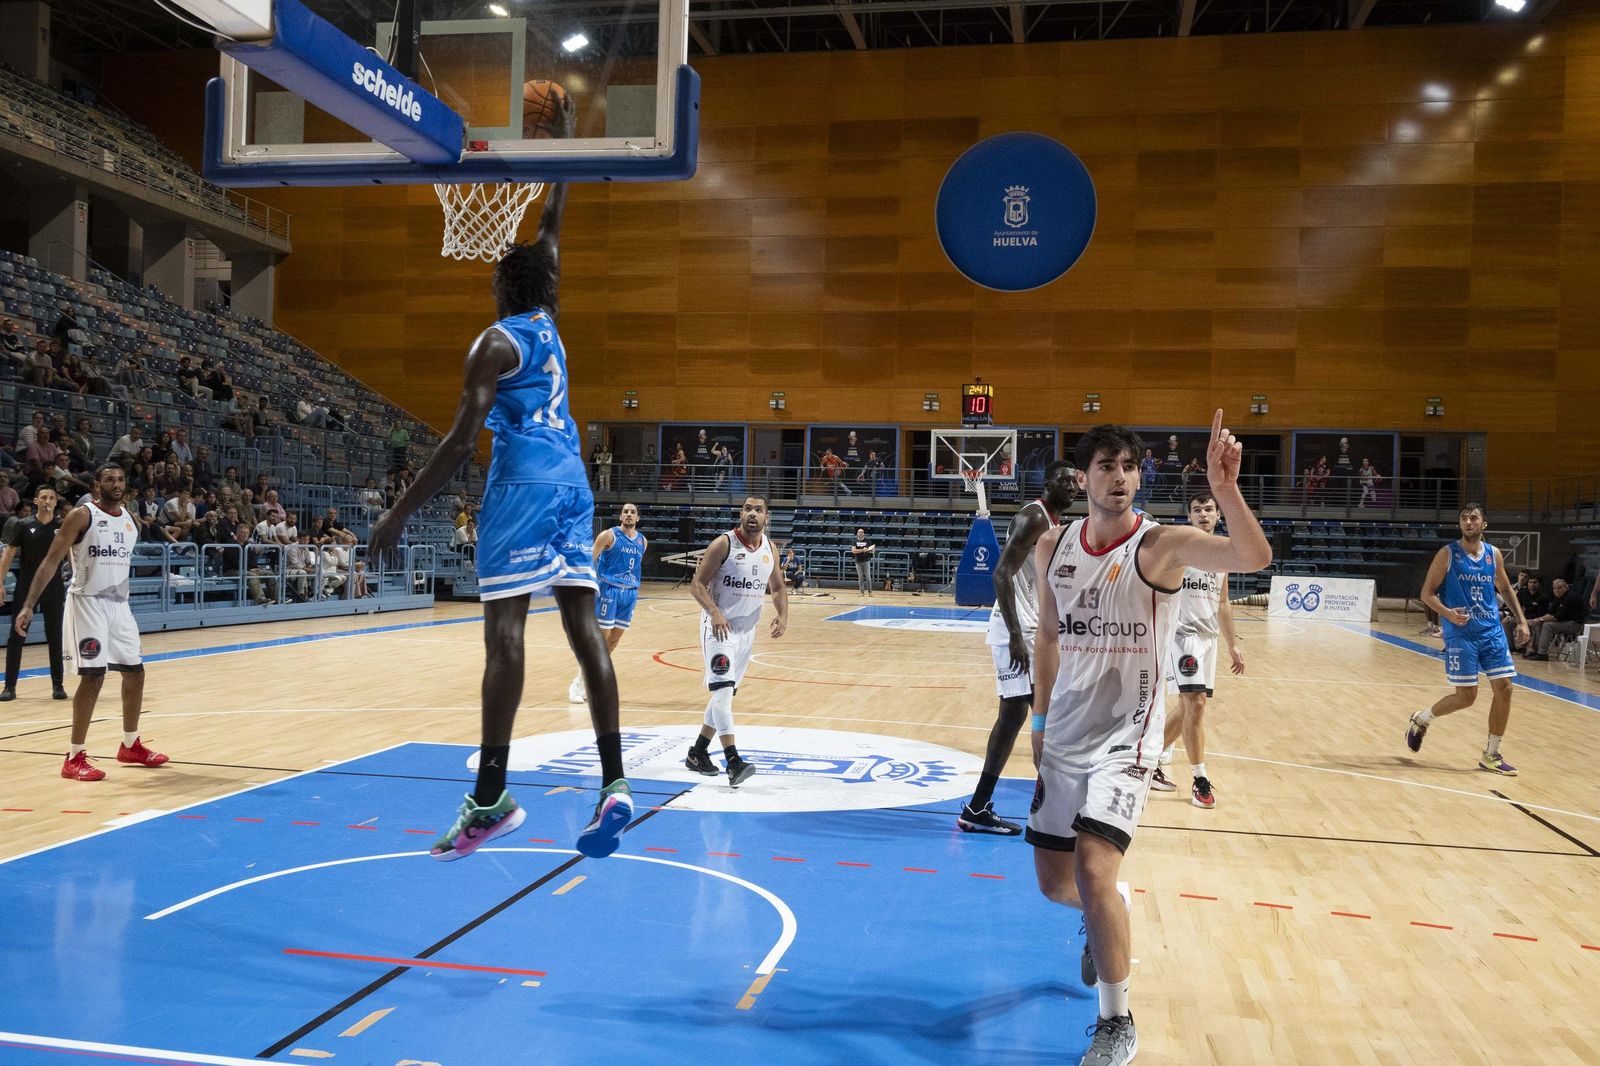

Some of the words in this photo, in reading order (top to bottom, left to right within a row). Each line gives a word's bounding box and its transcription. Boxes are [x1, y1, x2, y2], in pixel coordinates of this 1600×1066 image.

[352, 62, 422, 122] schelde
[993, 237, 1038, 246] HUELVA
[971, 397, 986, 413] 10
[113, 531, 125, 544] 31
[629, 557, 635, 570] 9
[752, 564, 758, 576] 6
[1077, 587, 1100, 610] 13
[1470, 586, 1484, 601] 55
[601, 603, 608, 616] 9
[1448, 655, 1461, 671] 55
[1138, 669, 1149, 708] CORTEBI
[1106, 786, 1137, 821] 13
